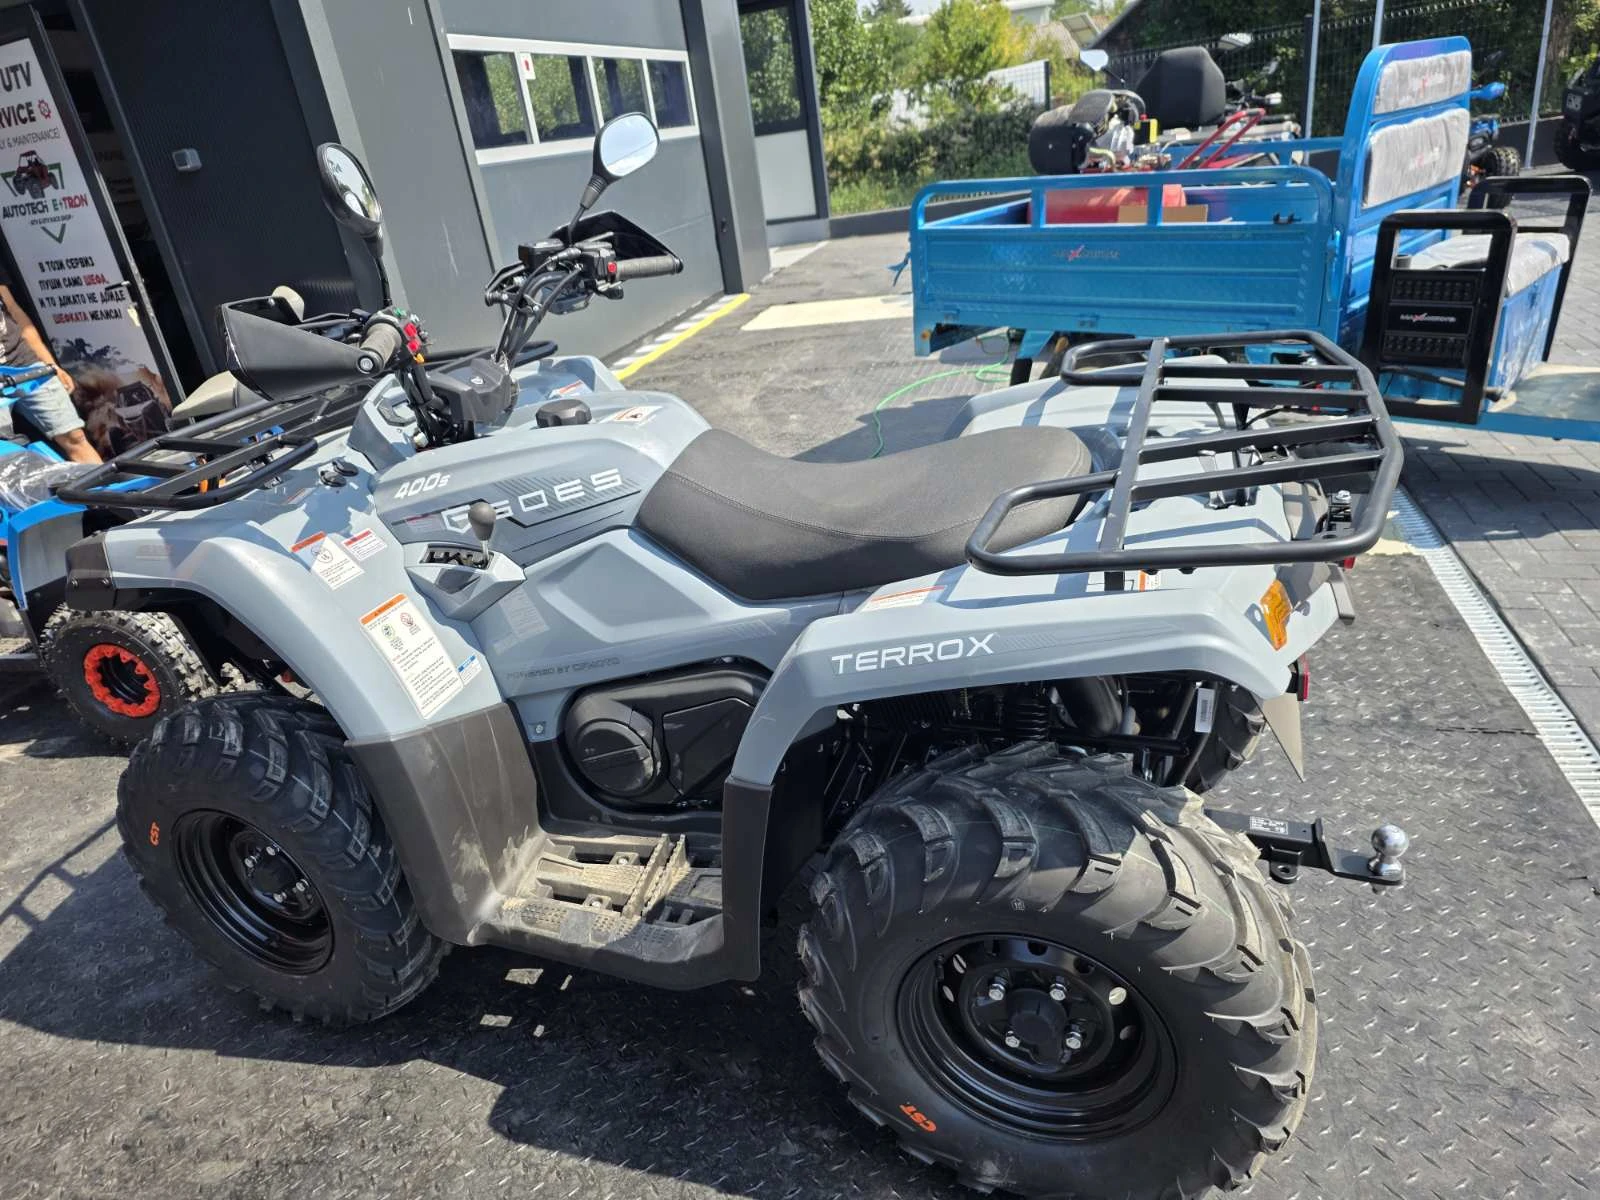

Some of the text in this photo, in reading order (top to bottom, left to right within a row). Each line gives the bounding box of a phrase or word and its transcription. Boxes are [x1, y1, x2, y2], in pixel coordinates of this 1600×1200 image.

[0, 61, 32, 92] UTV
[831, 631, 995, 675] TERROX
[899, 1103, 937, 1133] CST
